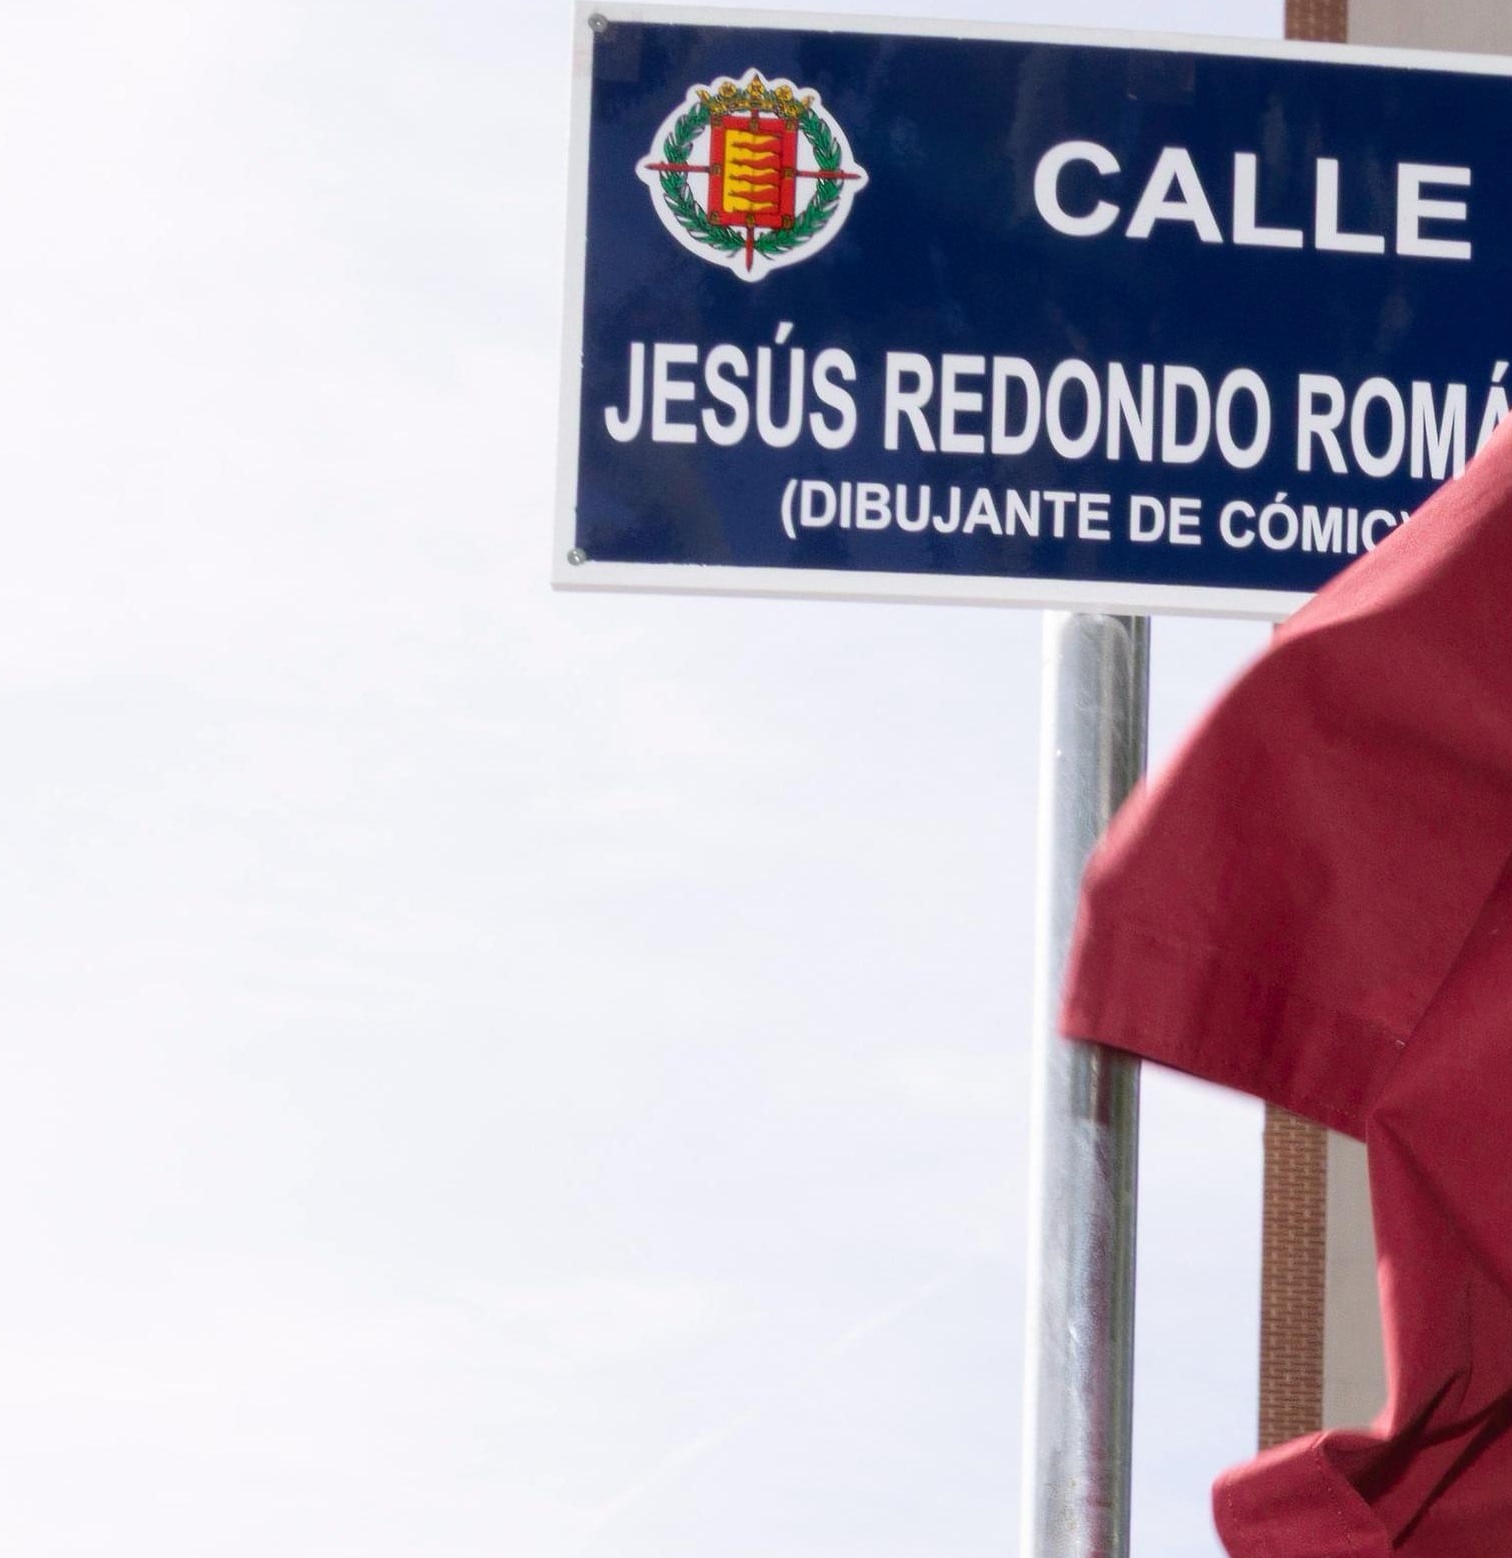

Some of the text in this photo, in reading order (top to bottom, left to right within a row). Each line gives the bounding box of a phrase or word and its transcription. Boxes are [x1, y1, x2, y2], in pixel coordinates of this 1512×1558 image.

[1033, 140, 1473, 260] CALLE
[604, 321, 859, 450] JESÚS
[883, 351, 1272, 470] REDONDO
[779, 478, 1411, 556] (DIBUJANTE DE CÓMIC
